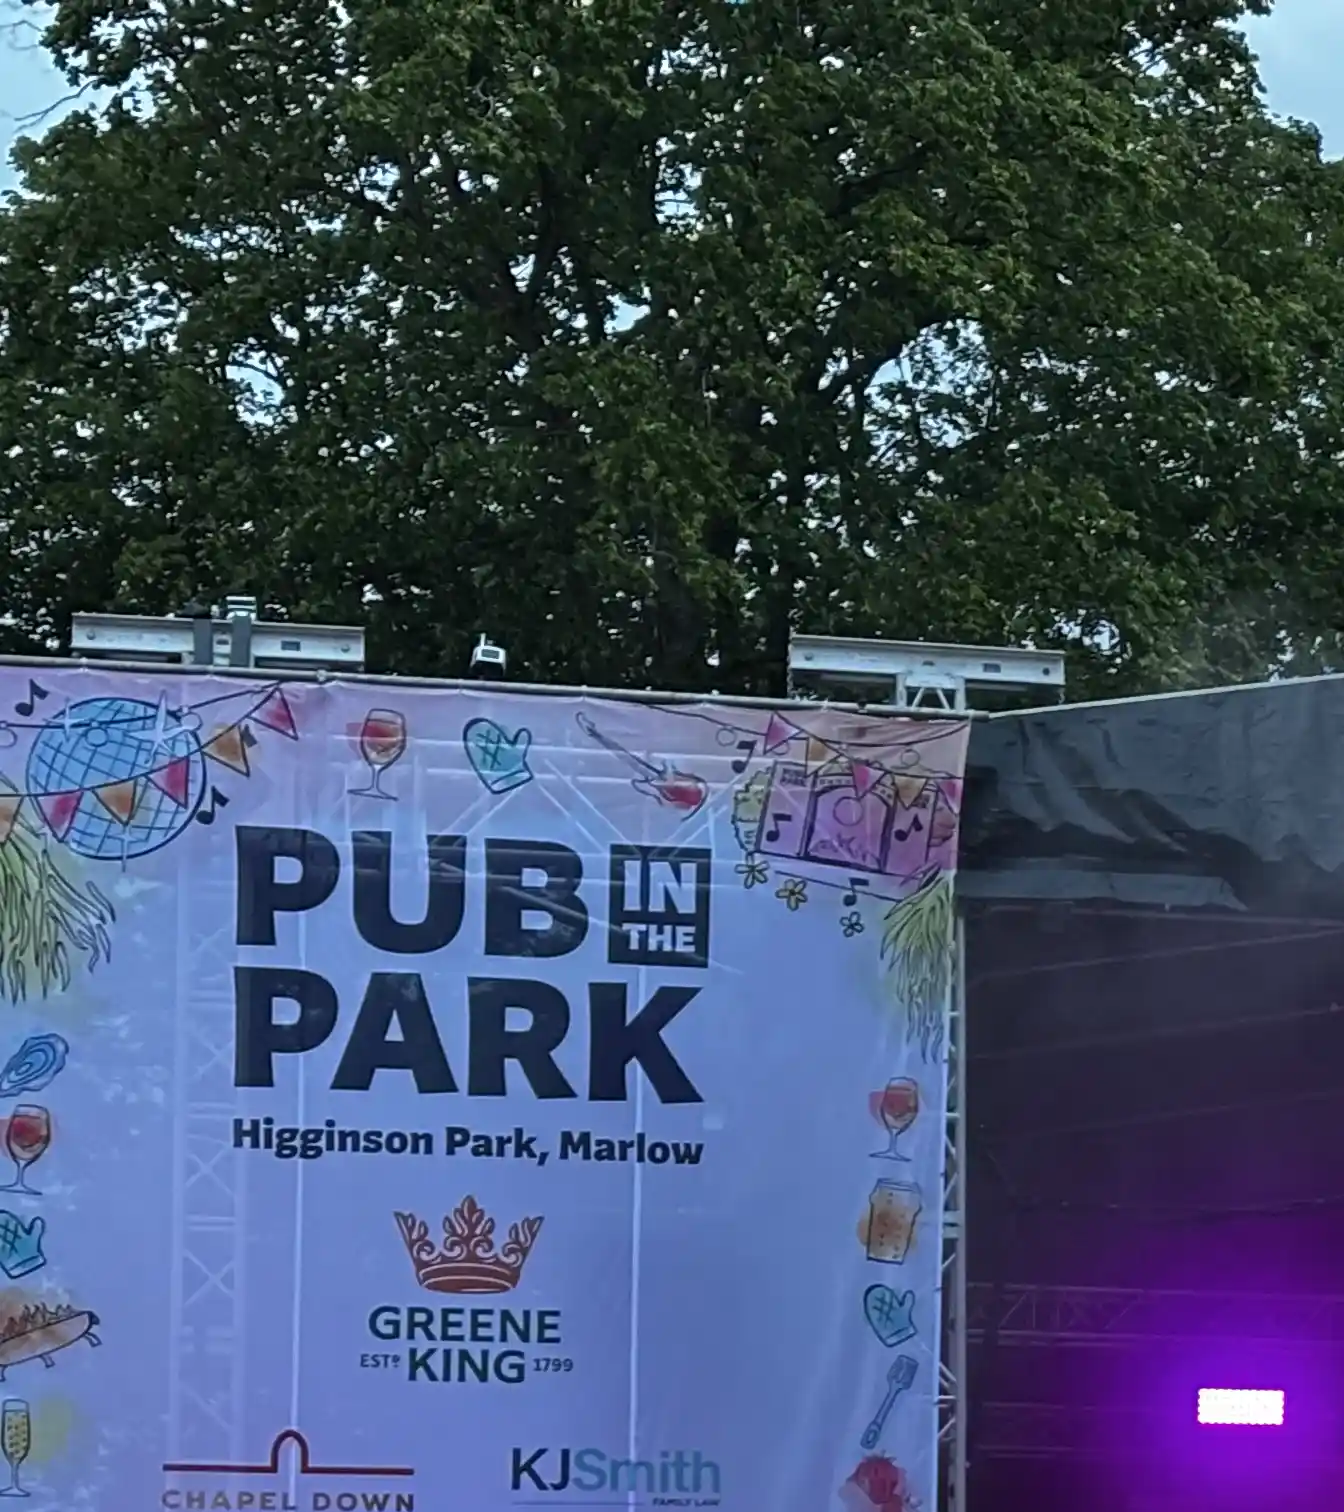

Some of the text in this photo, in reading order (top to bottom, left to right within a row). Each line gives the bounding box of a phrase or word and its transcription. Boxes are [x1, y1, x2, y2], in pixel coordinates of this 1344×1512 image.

[235, 825, 589, 958] PUB
[622, 859, 697, 914] IN
[622, 922, 697, 953] THE
[234, 966, 704, 1104] PARK
[233, 1117, 704, 1166] Higginson Park, Marlow
[368, 1305, 562, 1343] GREENE
[408, 1348, 525, 1383] KING
[533, 1358, 574, 1372] 1799
[161, 1489, 415, 1512] CHAPEL DOWN
